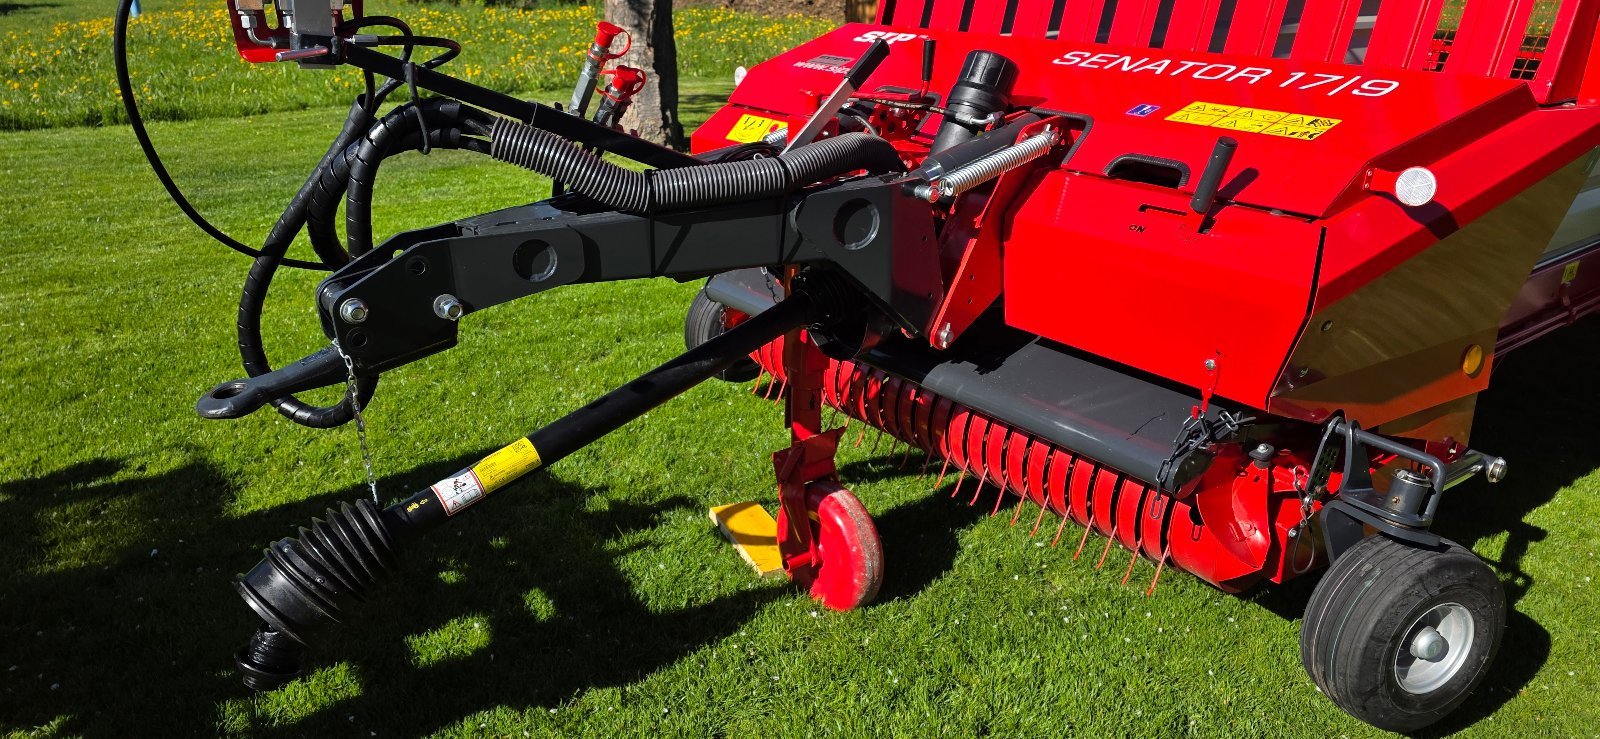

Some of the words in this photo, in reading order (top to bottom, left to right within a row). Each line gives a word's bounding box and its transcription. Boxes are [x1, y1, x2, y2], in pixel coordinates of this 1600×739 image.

[853, 31, 917, 45] SIP
[1052, 50, 1273, 85] SENATOR
[1128, 224, 1146, 233] ON
